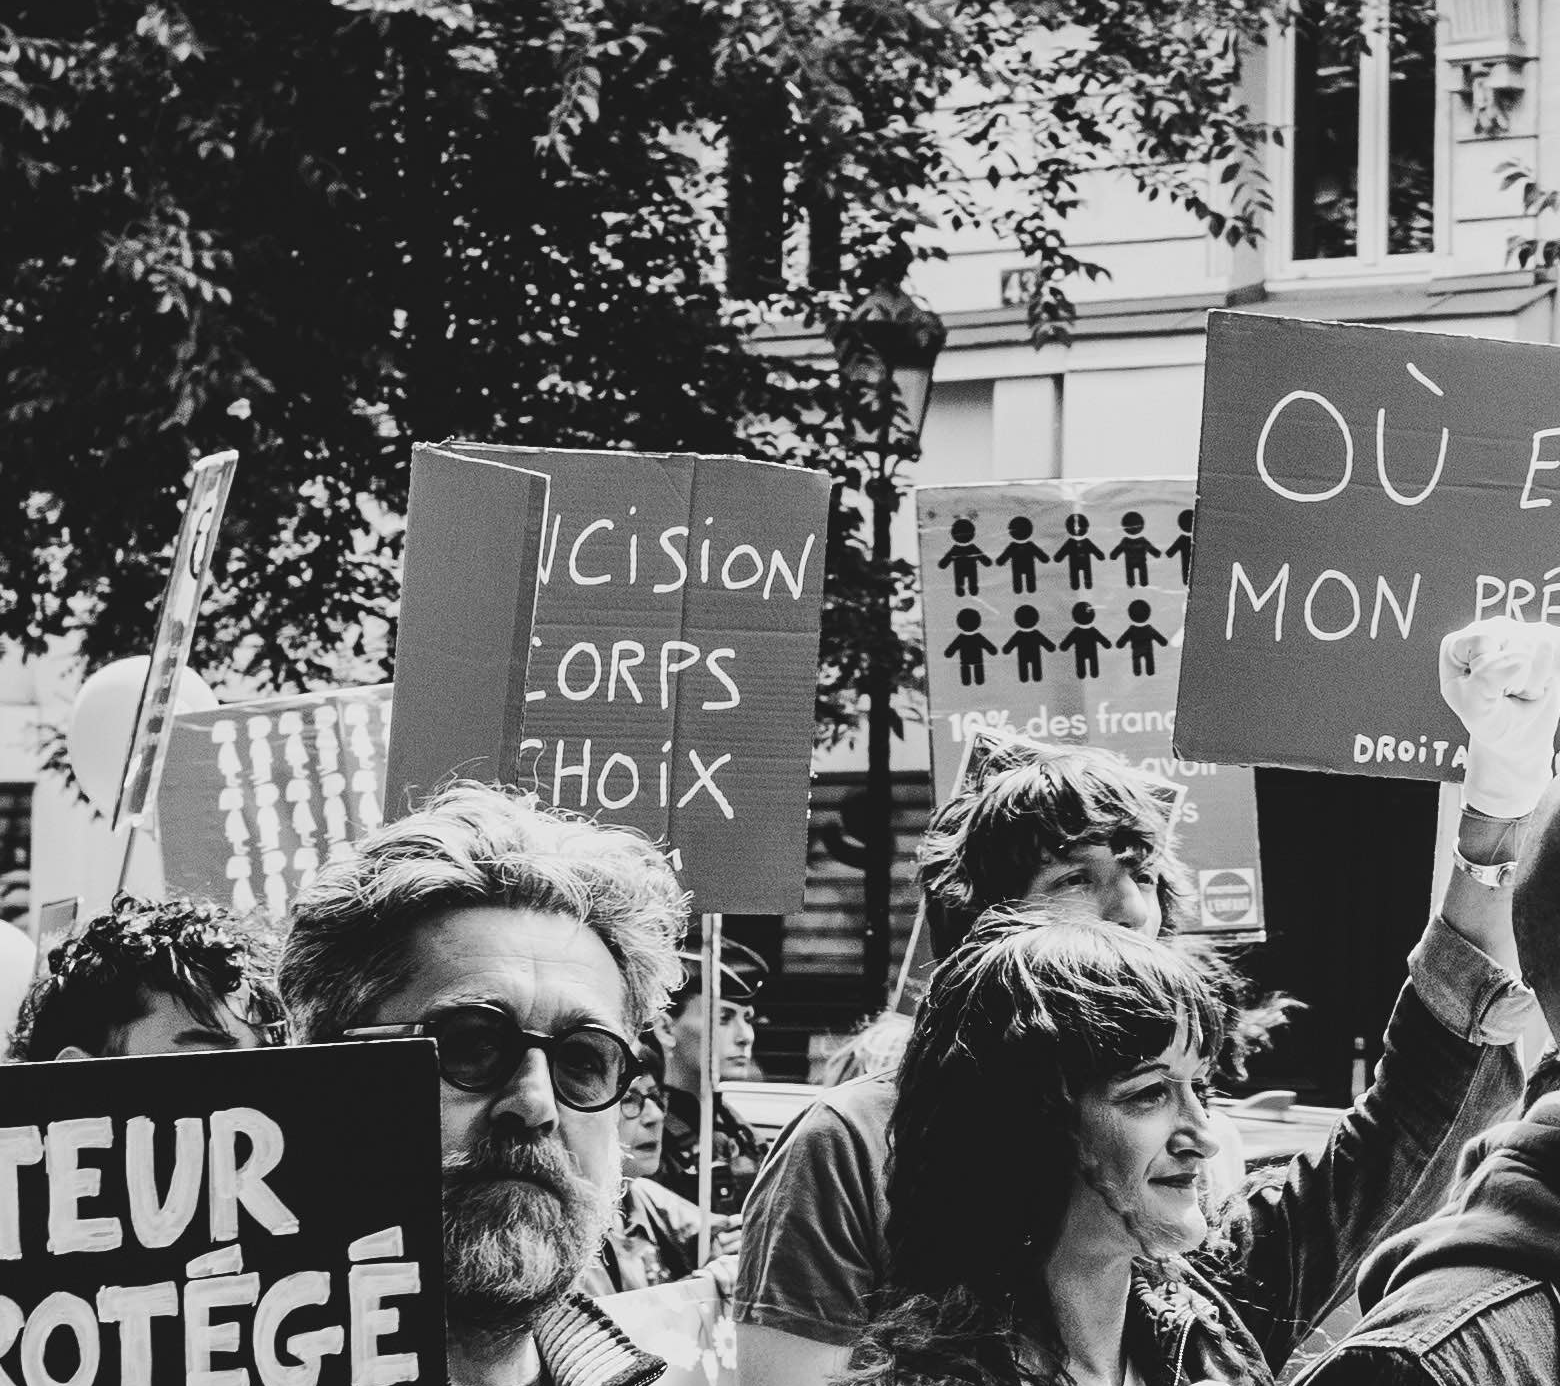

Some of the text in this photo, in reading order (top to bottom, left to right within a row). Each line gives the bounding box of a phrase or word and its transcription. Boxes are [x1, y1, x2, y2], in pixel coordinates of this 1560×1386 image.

[1255, 362, 1450, 506] OÙ
[1226, 562, 1421, 641] MON
[1027, 705, 1088, 738] des
